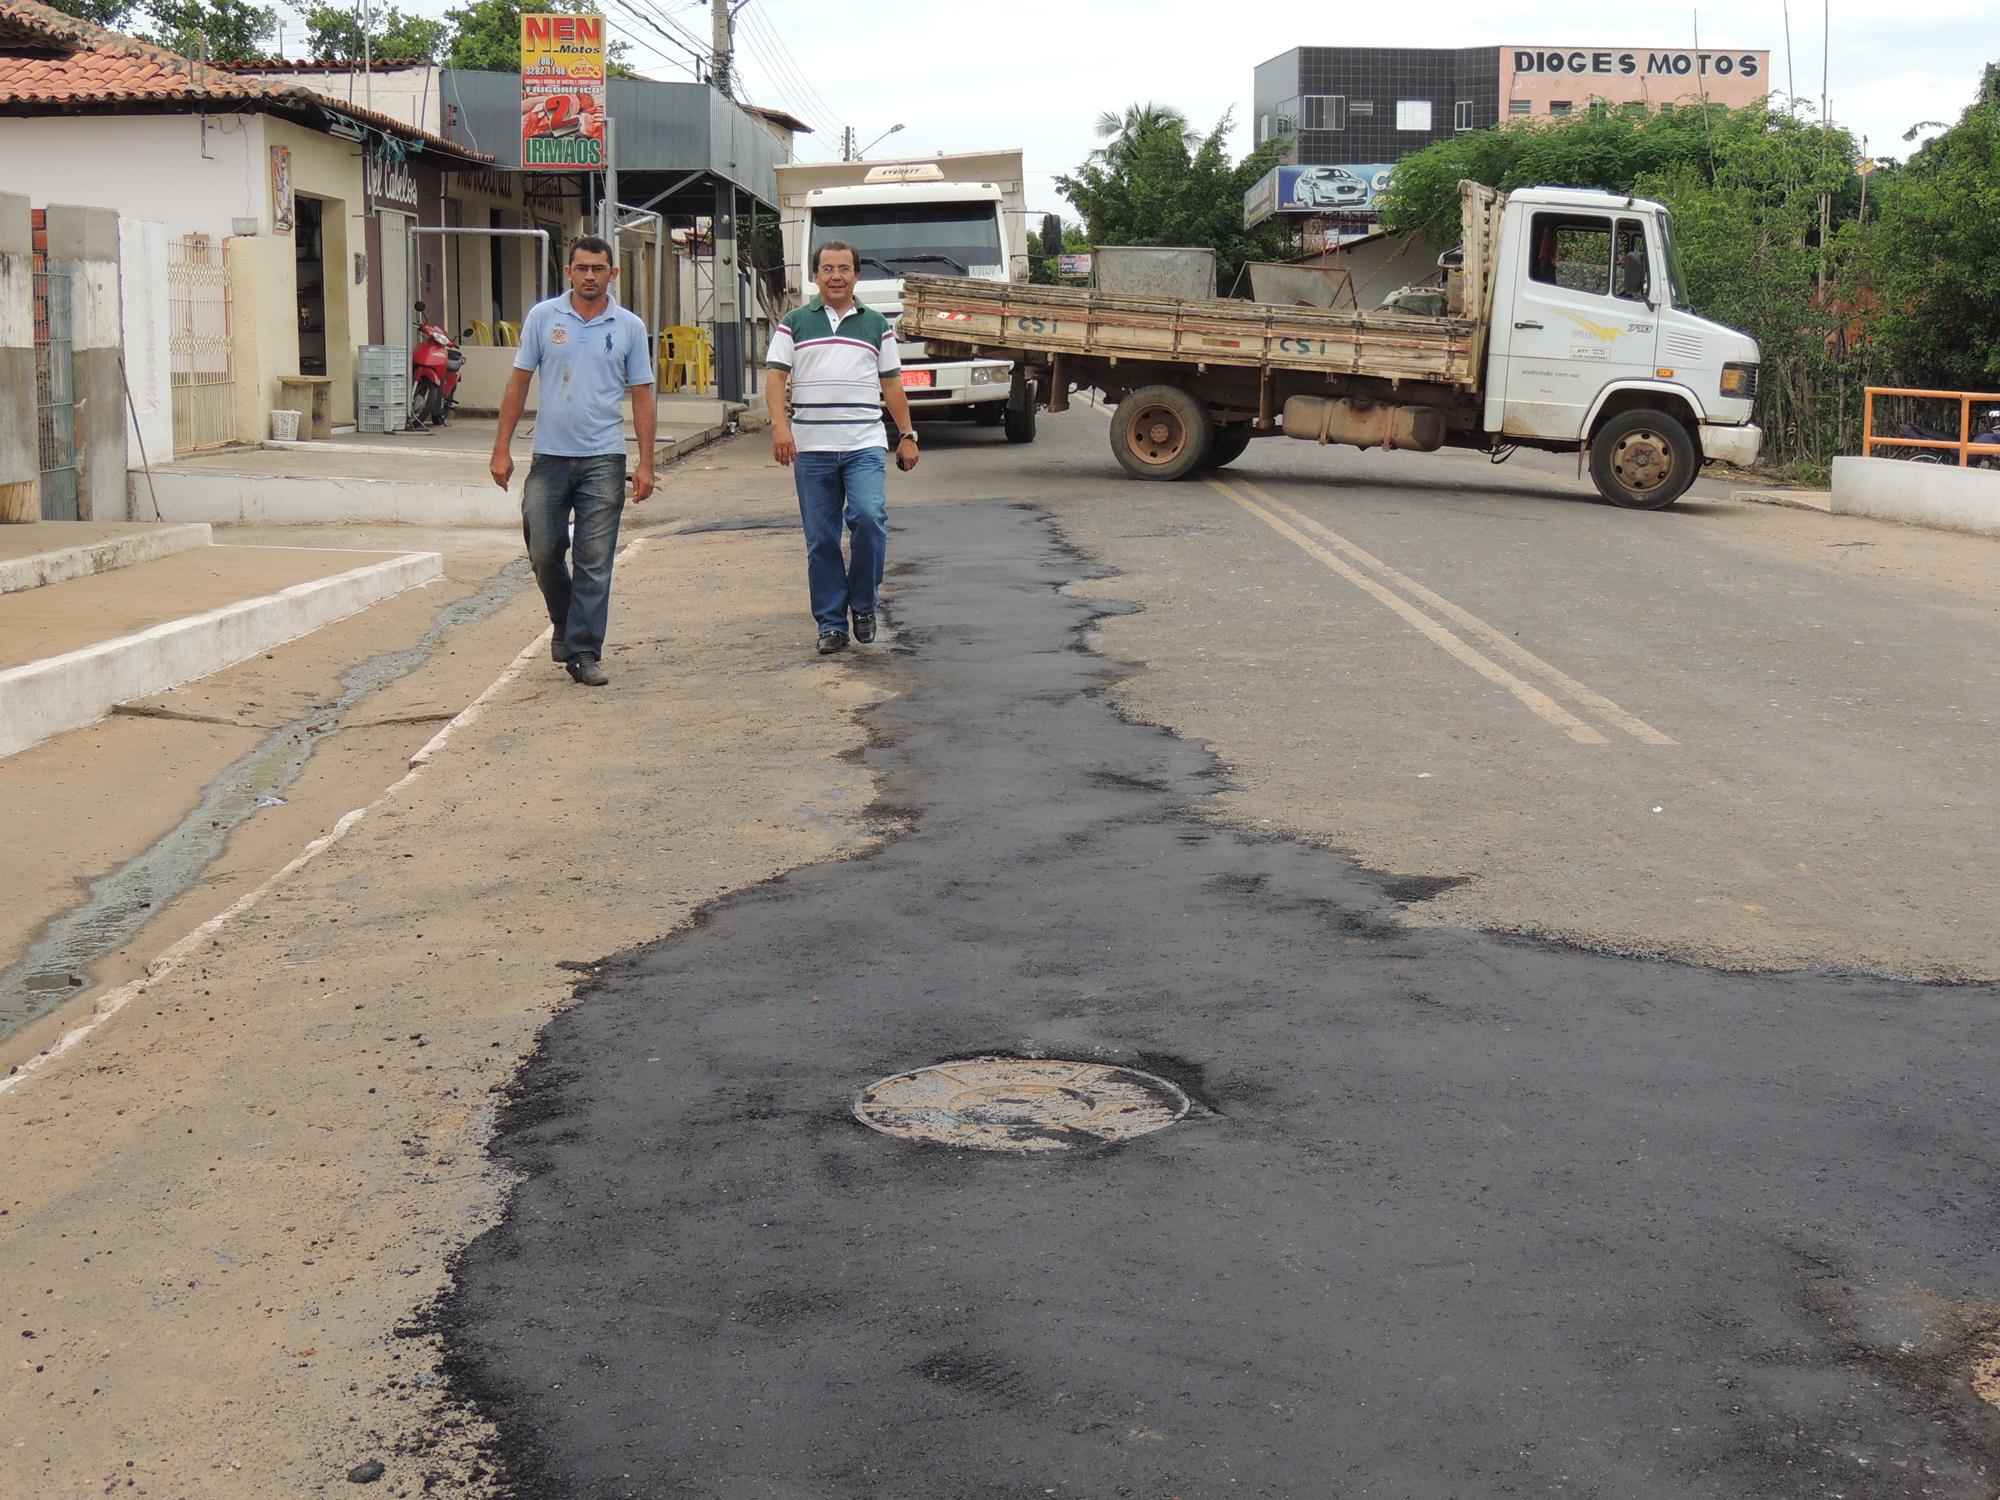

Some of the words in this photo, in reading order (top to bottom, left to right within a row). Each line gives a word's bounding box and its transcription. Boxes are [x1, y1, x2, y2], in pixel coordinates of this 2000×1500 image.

[526, 17, 600, 52] NEN
[560, 45, 600, 54] Motos
[1514, 51, 1636, 75] DIOGES
[1647, 53, 1758, 77] MOTOS
[545, 94, 580, 137] 2
[525, 135, 602, 165] IRMÃOS
[385, 159, 418, 209] Cabelos
[1627, 323, 1653, 333] 710
